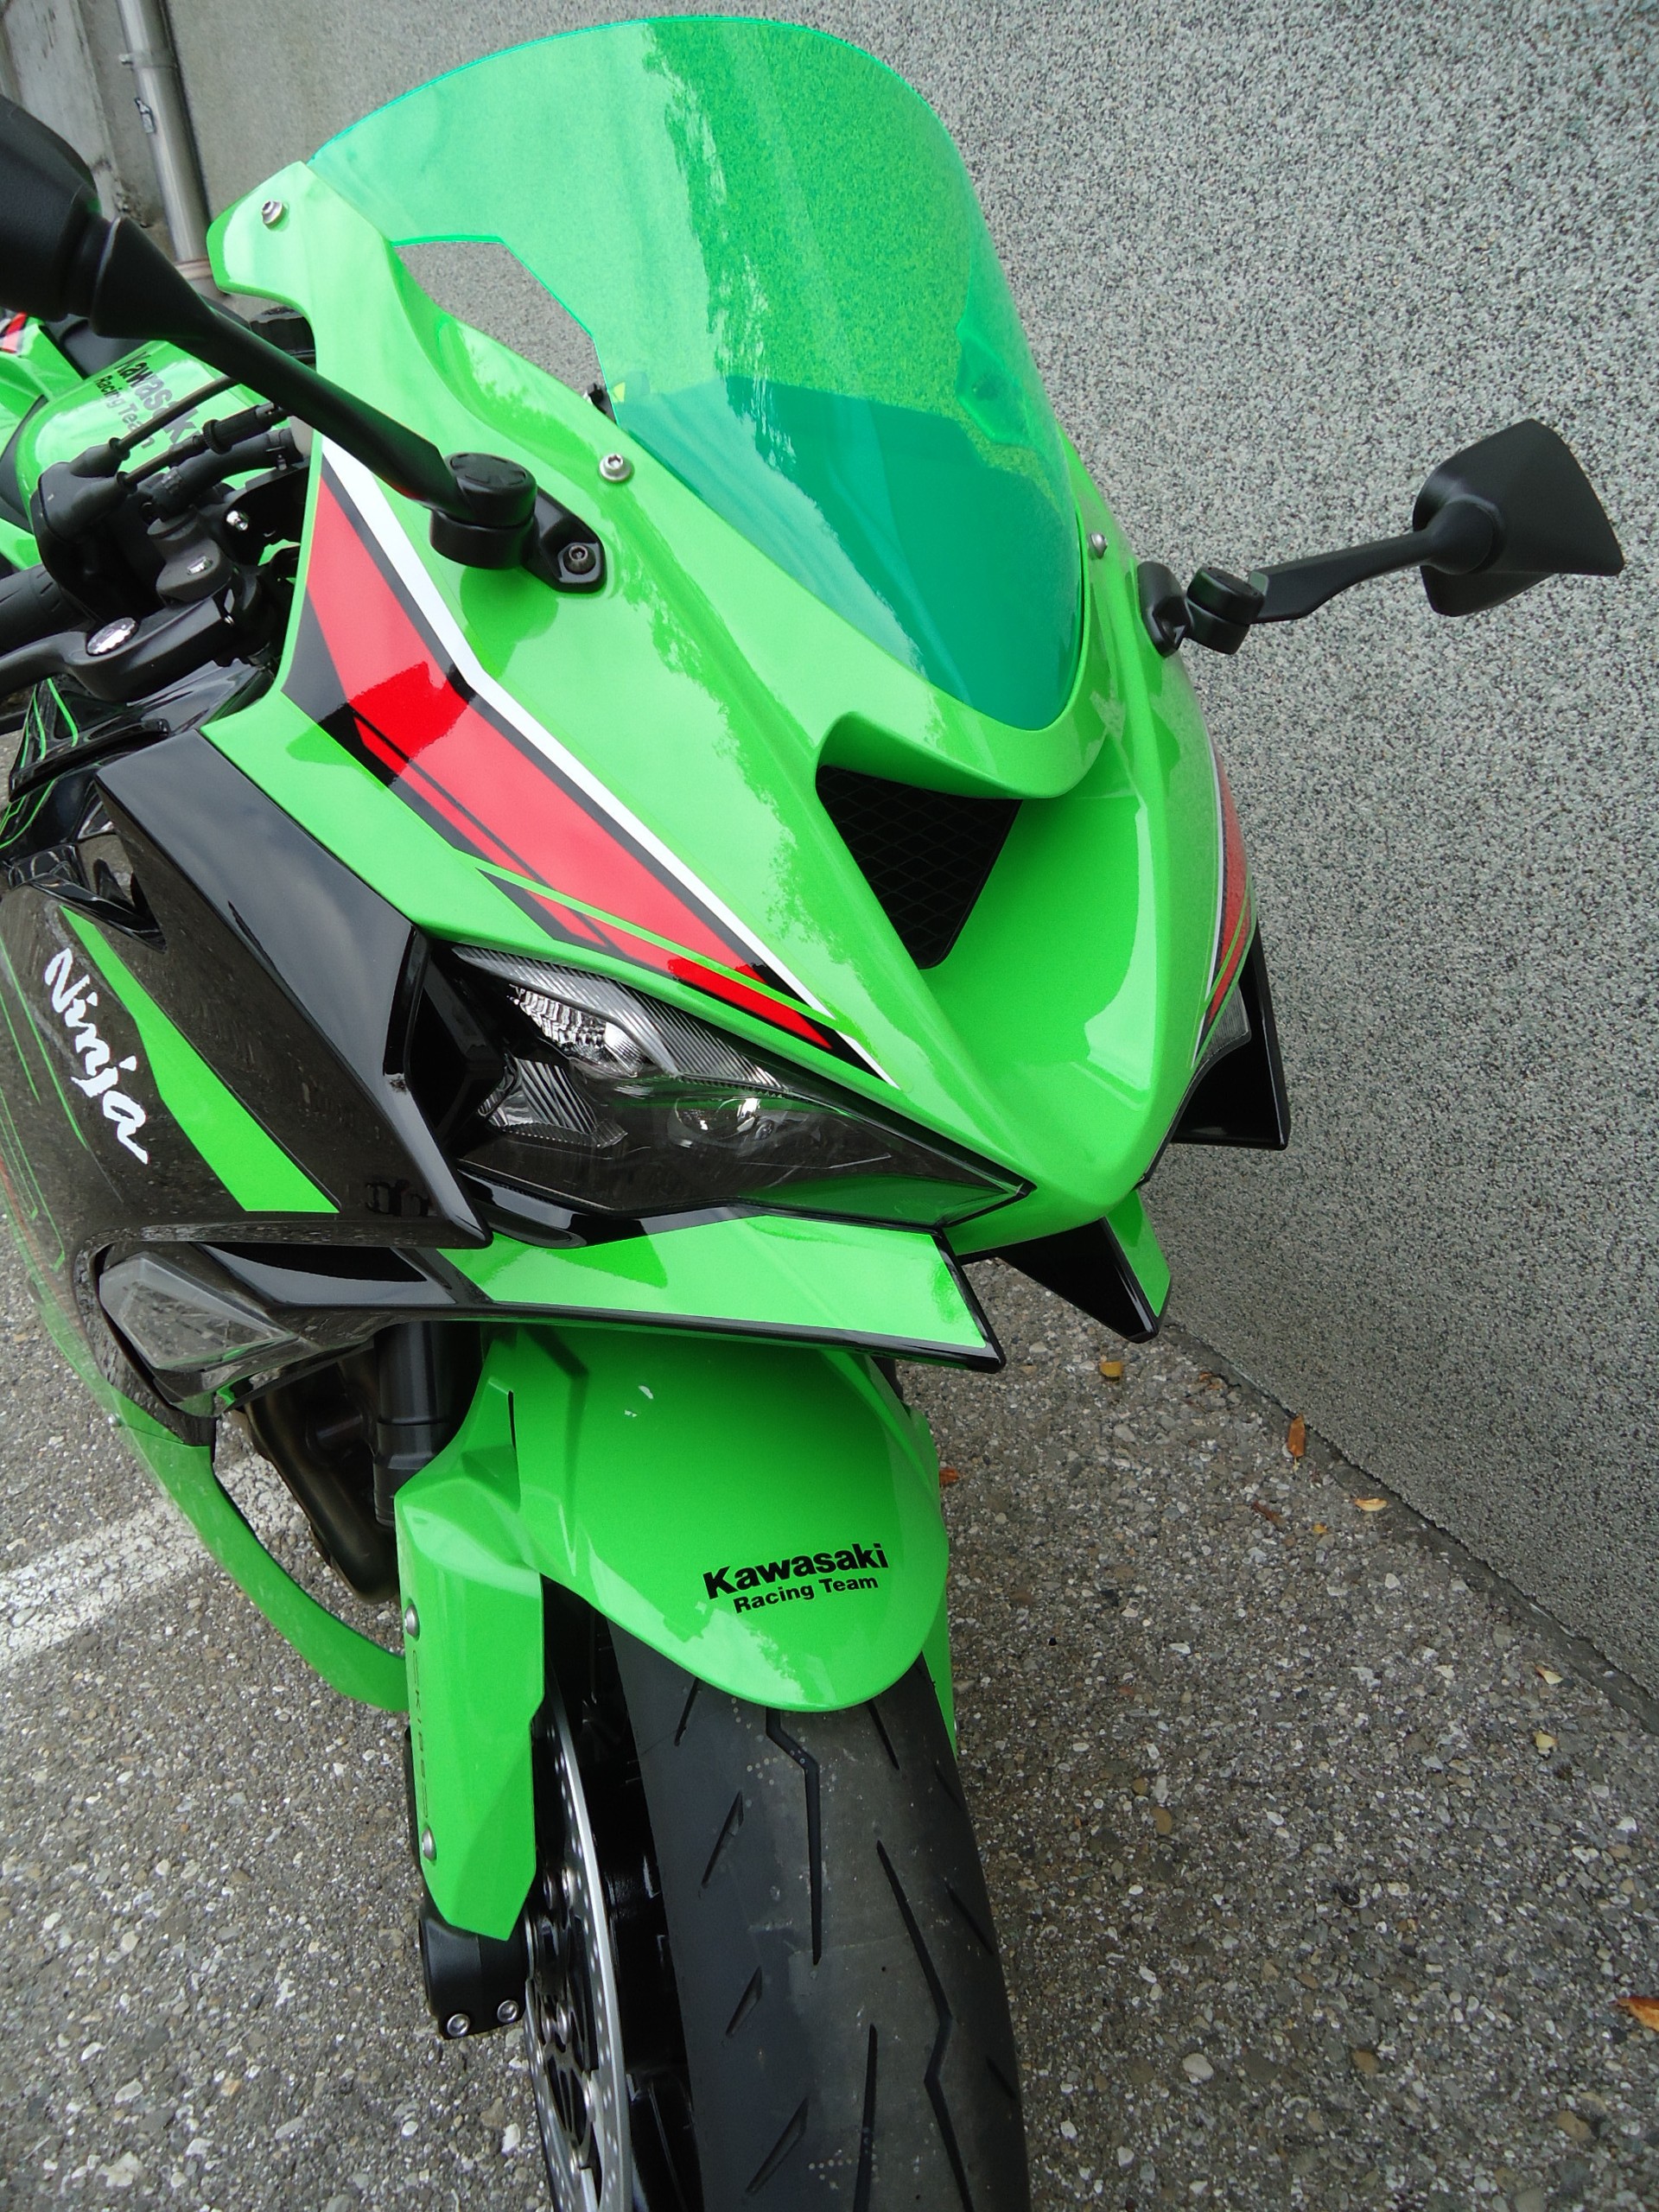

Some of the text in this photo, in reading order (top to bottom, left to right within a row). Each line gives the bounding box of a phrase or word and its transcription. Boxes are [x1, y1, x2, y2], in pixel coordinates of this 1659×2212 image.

[95, 374, 125, 409] Racing
[44, 948, 149, 1165] Ninja
[702, 1542, 889, 1600] Kawasaki
[734, 1577, 879, 1613] Racing Team
